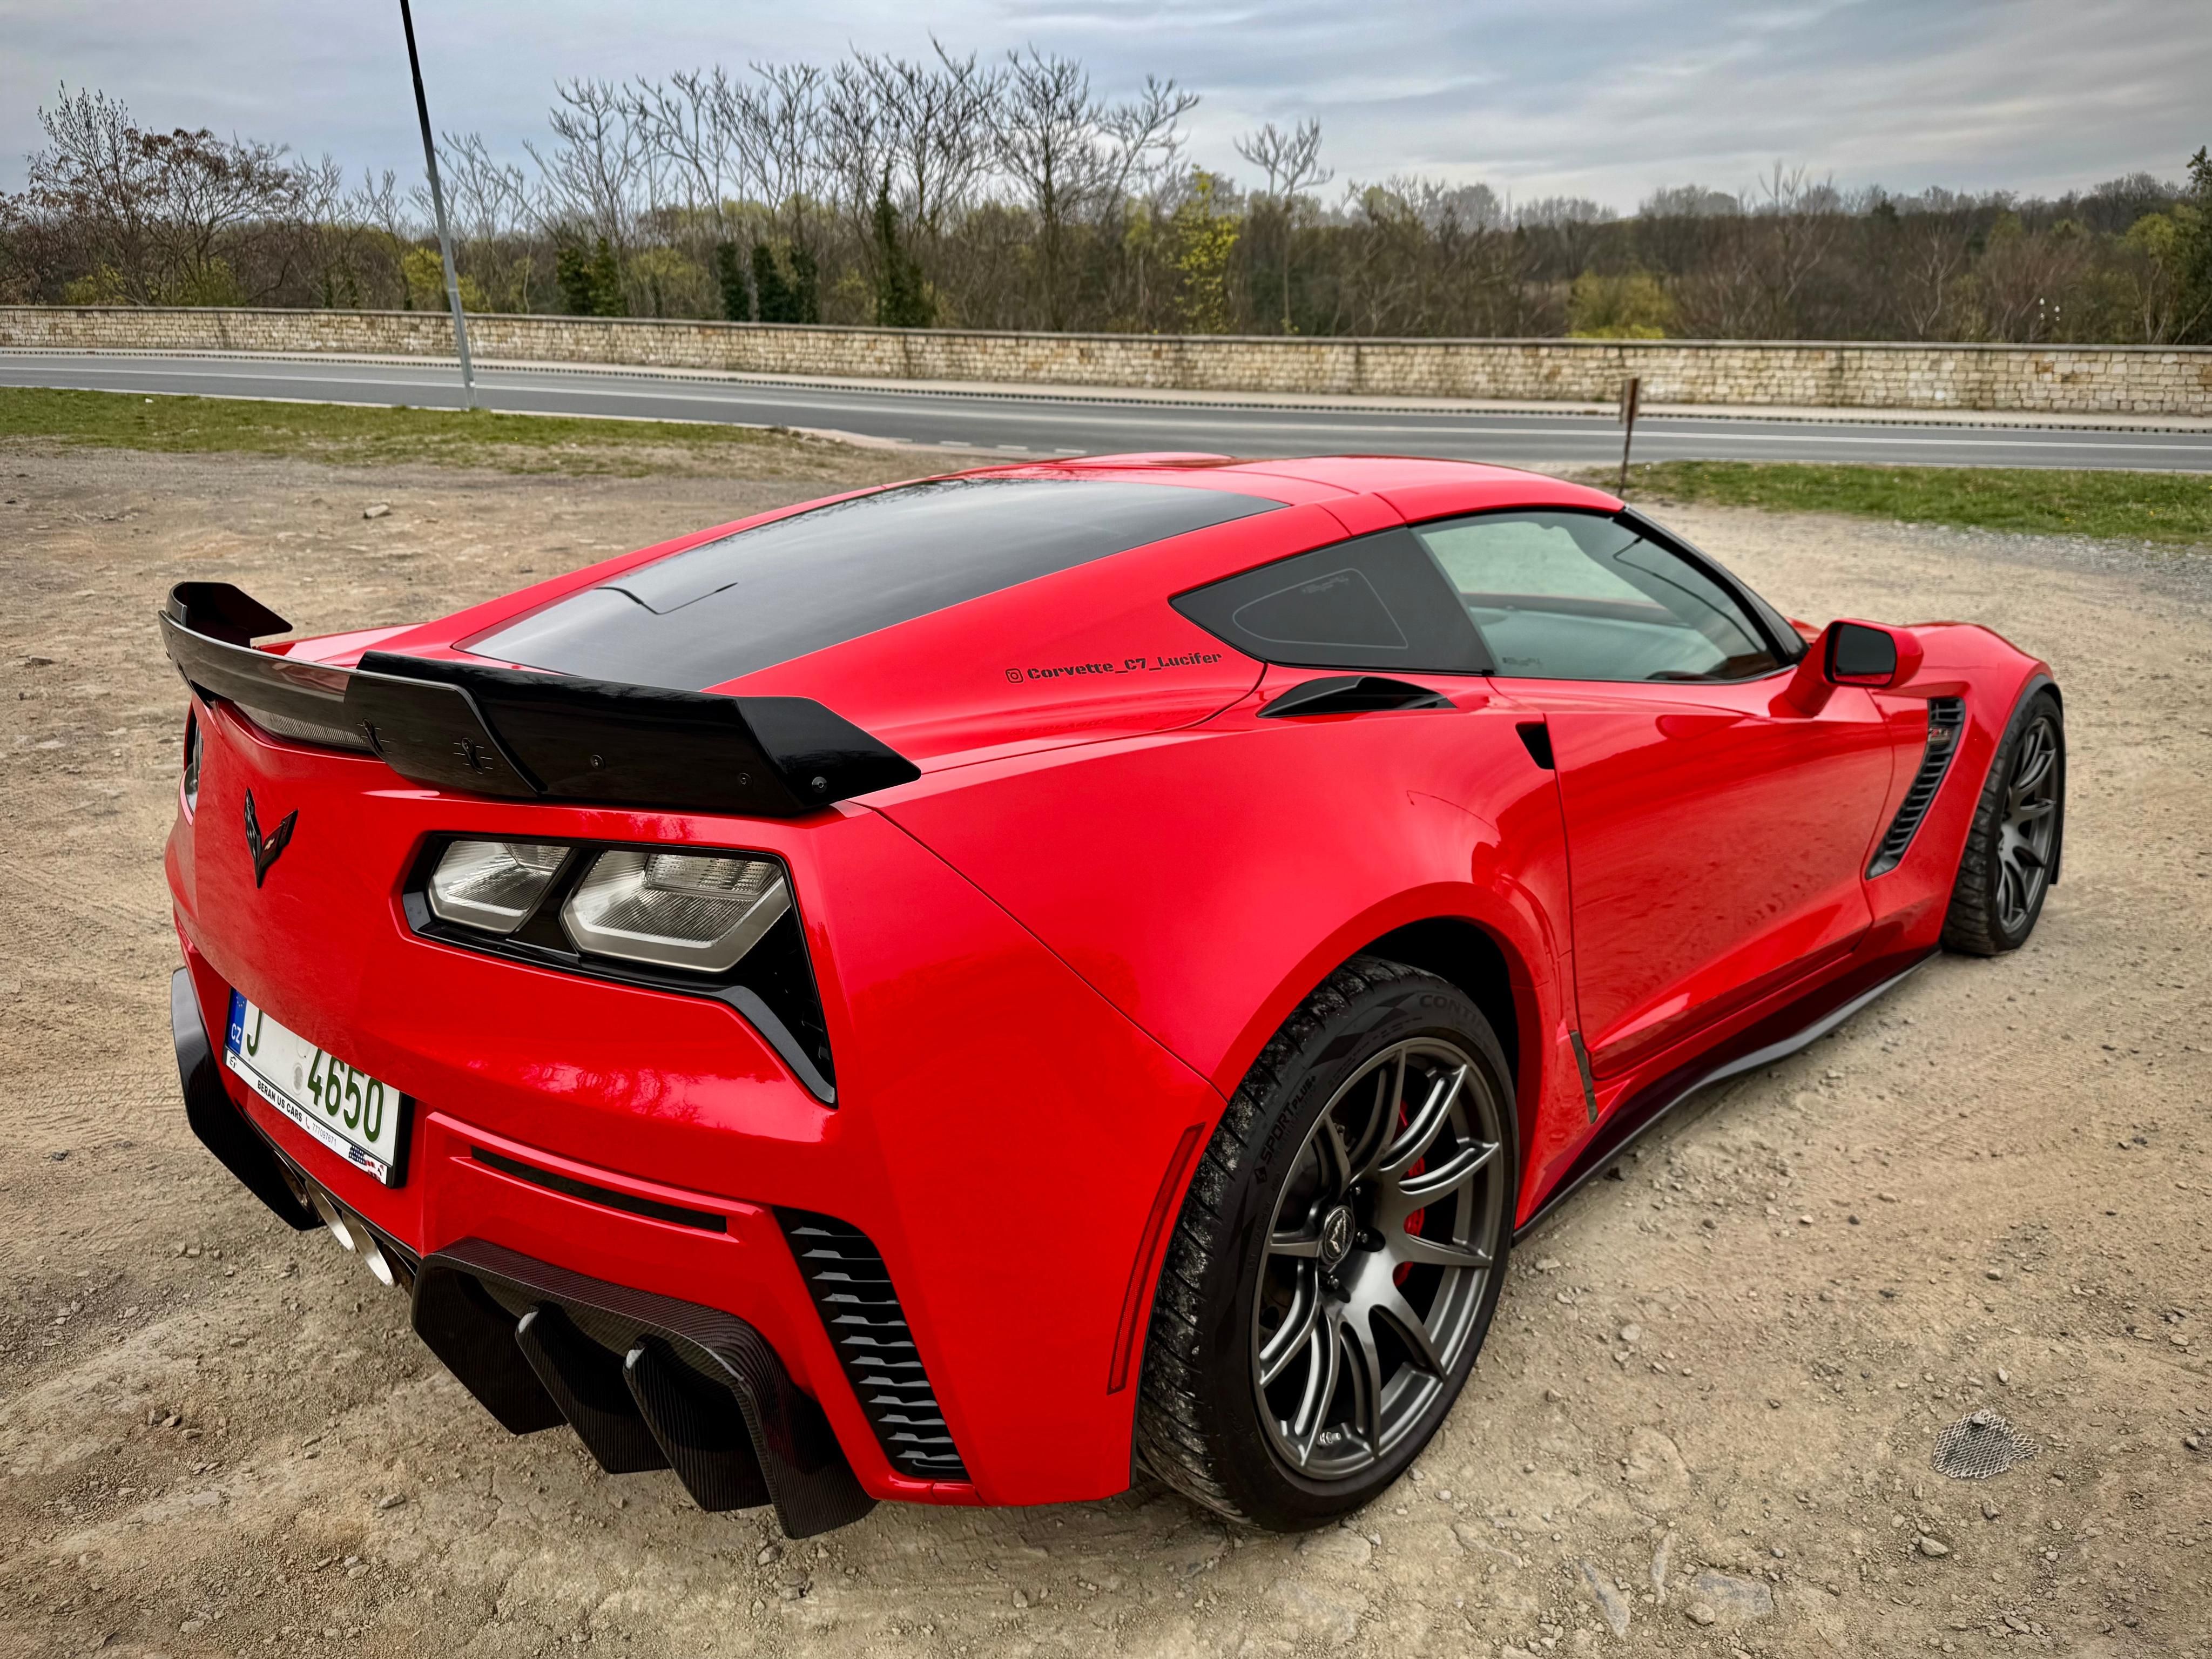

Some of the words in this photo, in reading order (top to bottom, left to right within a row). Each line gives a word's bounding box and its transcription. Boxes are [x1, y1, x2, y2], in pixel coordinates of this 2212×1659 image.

[1028, 652, 1223, 679] Corvette_C7_Lucifer
[231, 1023, 242, 1044] CZ
[258, 1080, 276, 1102] BERAN
[278, 1096, 285, 1109] US
[287, 1103, 302, 1122] CARS
[307, 1048, 384, 1142] 4650
